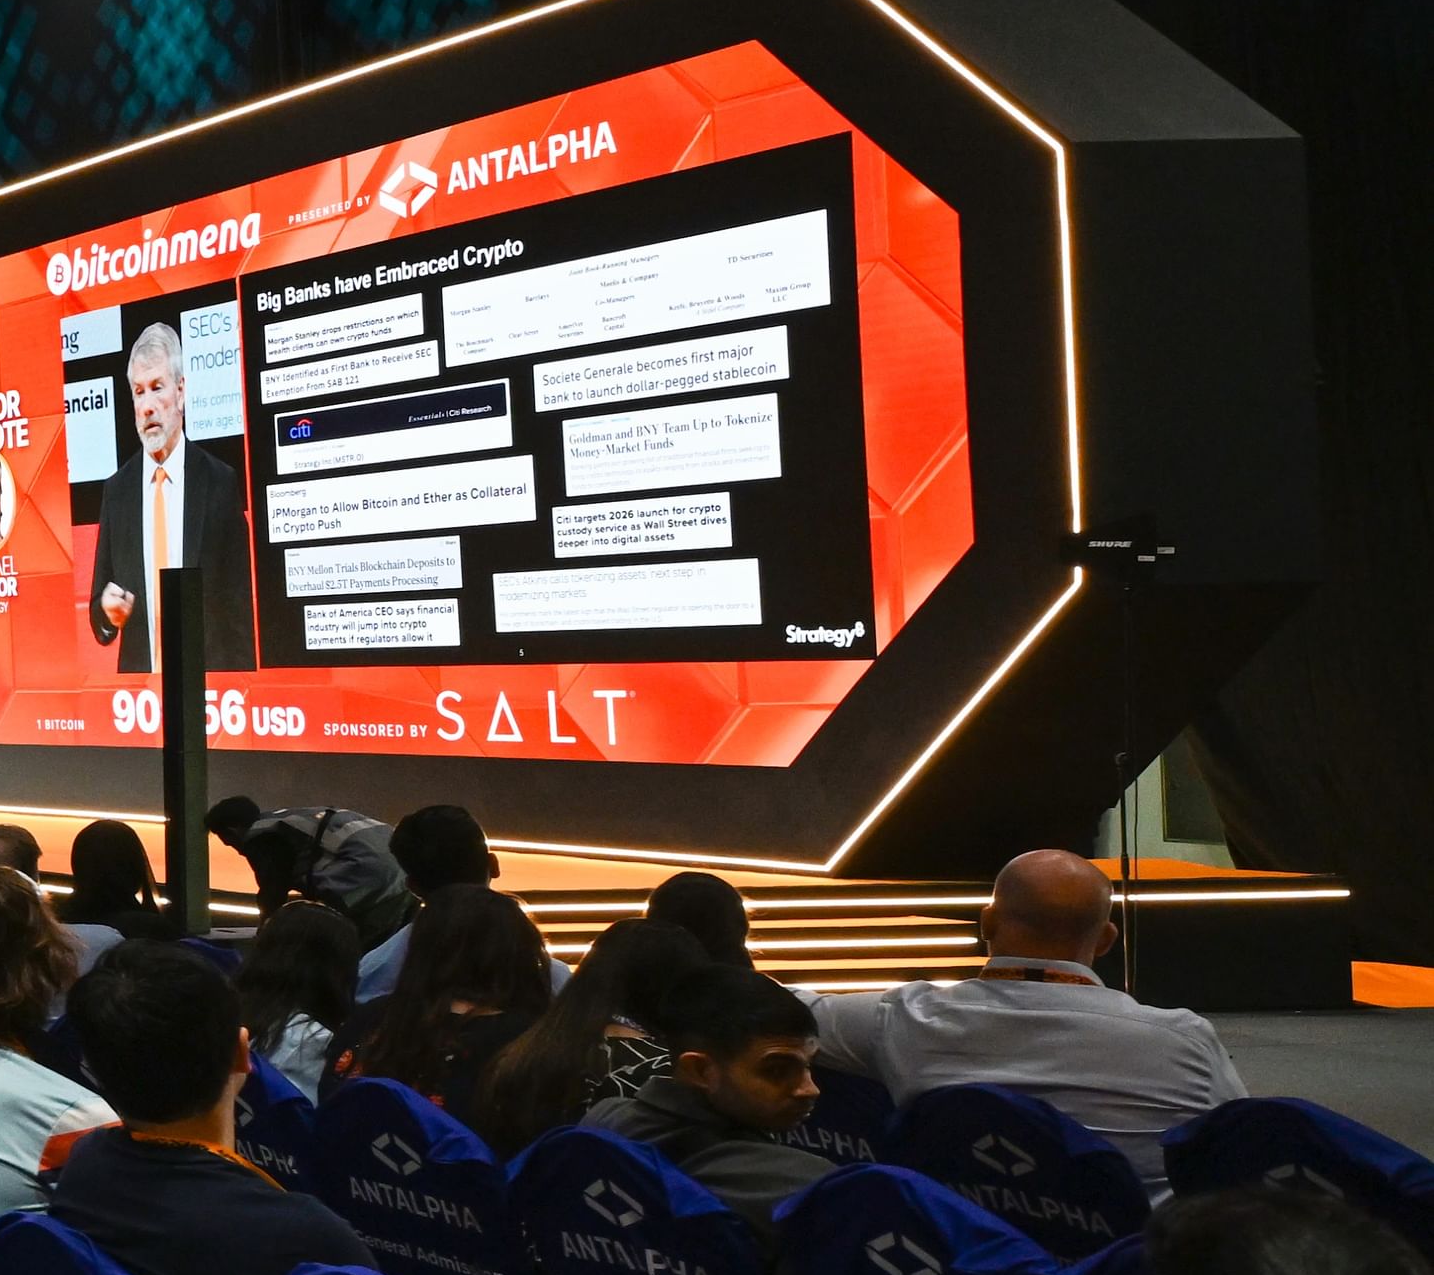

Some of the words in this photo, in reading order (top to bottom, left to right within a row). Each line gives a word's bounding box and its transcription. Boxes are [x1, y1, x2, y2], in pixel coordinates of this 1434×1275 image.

[446, 122, 617, 195] ANTALPHA
[288, 200, 352, 225] PRESENTED
[356, 194, 372, 210] BY
[69, 212, 262, 293] bitcoinmena
[257, 291, 281, 312] Big
[284, 282, 330, 304] Banks
[334, 274, 371, 293] have
[375, 250, 458, 284] Embraced
[463, 239, 523, 266] Crypto
[189, 312, 232, 339] SEC's
[267, 336, 292, 344] Morgan
[295, 331, 319, 340] Stanley
[321, 326, 341, 334] drops
[343, 318, 383, 329] restrictions
[397, 310, 419, 319] which
[346, 332, 368, 341] crypto
[371, 327, 391, 335] funds
[265, 376, 280, 384] BNY
[282, 369, 318, 381] Identified
[330, 363, 348, 371] First
[349, 360, 370, 369] Bank
[381, 353, 413, 363] Receive
[415, 347, 431, 358] SEC
[542, 372, 580, 385] Societe
[583, 363, 633, 379] Generale
[636, 356, 687, 371] becomes
[691, 351, 714, 362] first
[718, 345, 752, 360] major
[266, 386, 304, 397] Exemption
[306, 382, 325, 390] From
[326, 377, 342, 387] SAB
[344, 375, 358, 384] 121
[543, 392, 569, 404] bank
[572, 391, 583, 400] to
[586, 384, 622, 398] launch
[625, 372, 708, 392] dollar-pegged
[712, 362, 776, 380] stablecoin
[290, 422, 311, 438] citi
[569, 432, 612, 442] Goldman
[614, 427, 633, 439] and
[636, 424, 658, 437] BNY
[662, 422, 689, 434] Team
[692, 418, 707, 432] Up
[710, 418, 721, 428] to
[724, 412, 772, 425] Tokenize
[570, 442, 640, 457] Money-Market
[644, 438, 673, 450] Funds
[272, 507, 317, 518] JPMorgan
[319, 505, 329, 513] to
[332, 502, 358, 511] Allow
[362, 499, 398, 509] Bitcoin
[400, 494, 420, 506] and
[423, 492, 451, 503] Ether
[455, 491, 467, 500] as
[470, 484, 526, 498] Collateral
[556, 516, 571, 524] Citi
[573, 514, 606, 523] targets
[608, 509, 634, 519] 2026
[636, 508, 669, 517] launch
[672, 506, 685, 514] for
[688, 504, 721, 514] crypto
[282, 522, 315, 534] Crypto
[317, 518, 341, 529] Push
[557, 527, 592, 535] custody
[594, 524, 627, 532] service
[643, 520, 664, 528] Wall
[667, 518, 697, 527] Street
[700, 516, 726, 525] dives
[611, 534, 641, 545] digital
[644, 533, 674, 541] assets
[288, 566, 305, 576] BNY
[307, 564, 333, 574] Mellon
[334, 562, 358, 572] Trials
[360, 560, 405, 571] Blockchain
[407, 558, 444, 570] Deposits
[446, 557, 455, 565] to
[288, 581, 324, 591] Overhaul
[325, 578, 348, 589] $2.5T
[349, 578, 390, 590] Payments
[391, 575, 438, 586] Processing
[306, 610, 326, 618] Bank
[328, 609, 336, 618] of
[339, 608, 372, 616] America
[374, 606, 393, 615] CEO
[395, 607, 414, 616] says
[417, 605, 454, 613] financial
[307, 624, 339, 632] industry
[357, 622, 378, 631] jump
[399, 620, 426, 630] crypto
[308, 636, 346, 647] payments
[348, 634, 354, 642] if
[356, 635, 398, 645] regulators
[401, 634, 424, 642] allow
[426, 633, 432, 641] it
[45, 719, 85, 731] BITCOIN
[252, 706, 306, 736] USD
[436, 690, 628, 746] SALT
[324, 723, 404, 738] SPONSORED
[409, 724, 428, 738] BY
[350, 1176, 483, 1233] ANTALPHA
